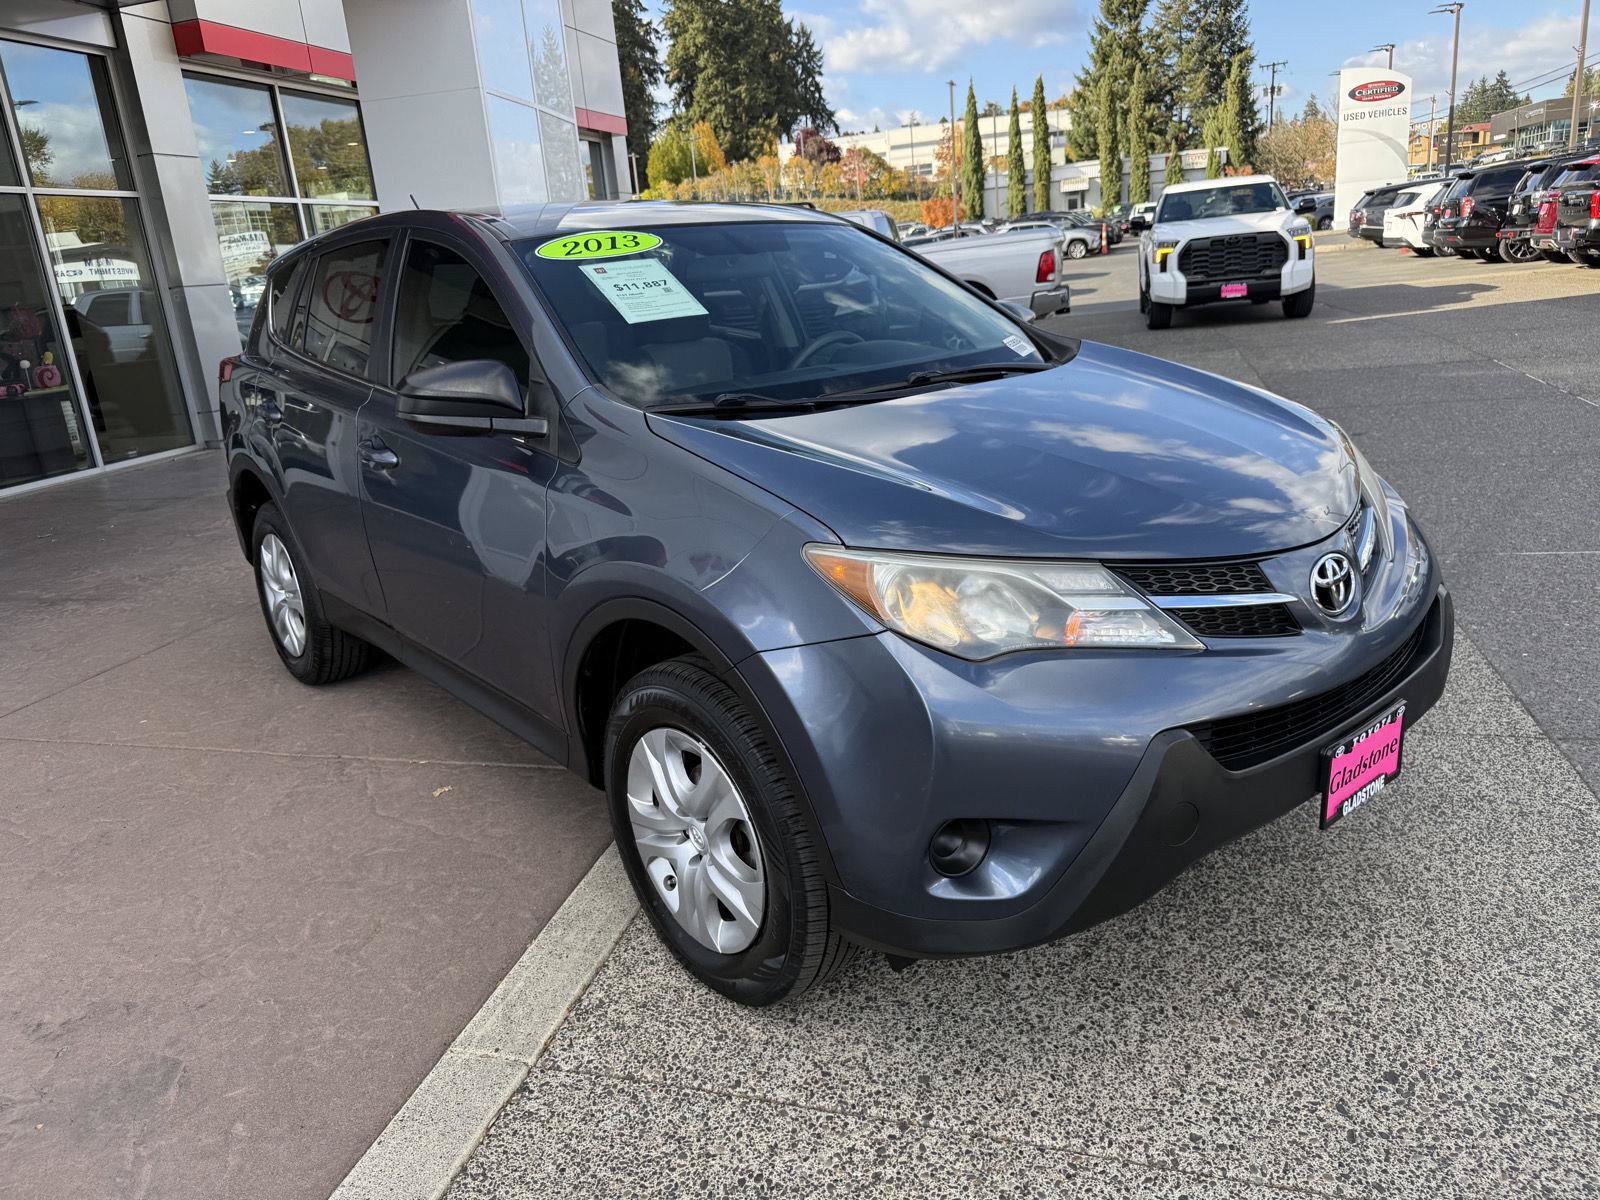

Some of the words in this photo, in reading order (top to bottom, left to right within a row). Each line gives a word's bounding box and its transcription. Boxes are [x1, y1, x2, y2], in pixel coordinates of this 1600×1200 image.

[1343, 112, 1366, 121] USED
[1368, 106, 1408, 119] VEHICLES
[562, 235, 641, 257] 2013
[613, 279, 668, 292] $11,887
[1352, 714, 1392, 747] TOYOTA
[1330, 737, 1398, 795] Gladstone
[1342, 774, 1386, 816] GLADSTONE
